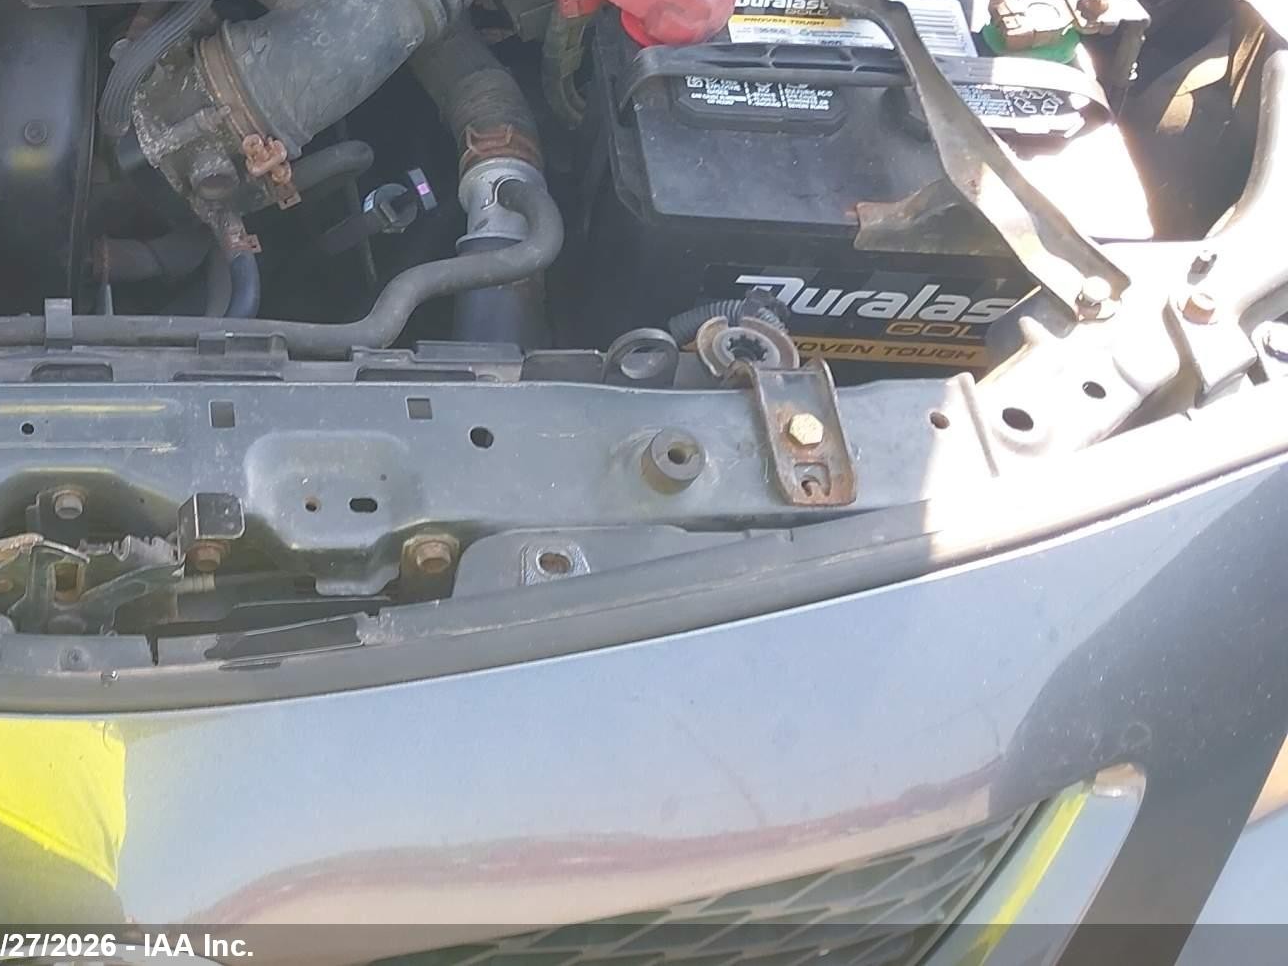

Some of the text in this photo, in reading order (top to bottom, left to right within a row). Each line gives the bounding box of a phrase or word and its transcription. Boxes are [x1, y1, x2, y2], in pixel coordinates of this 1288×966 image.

[735, 274, 1017, 324] Duralas
[885, 320, 982, 339] GOL
[795, 340, 977, 360] OVEN TOUGH
